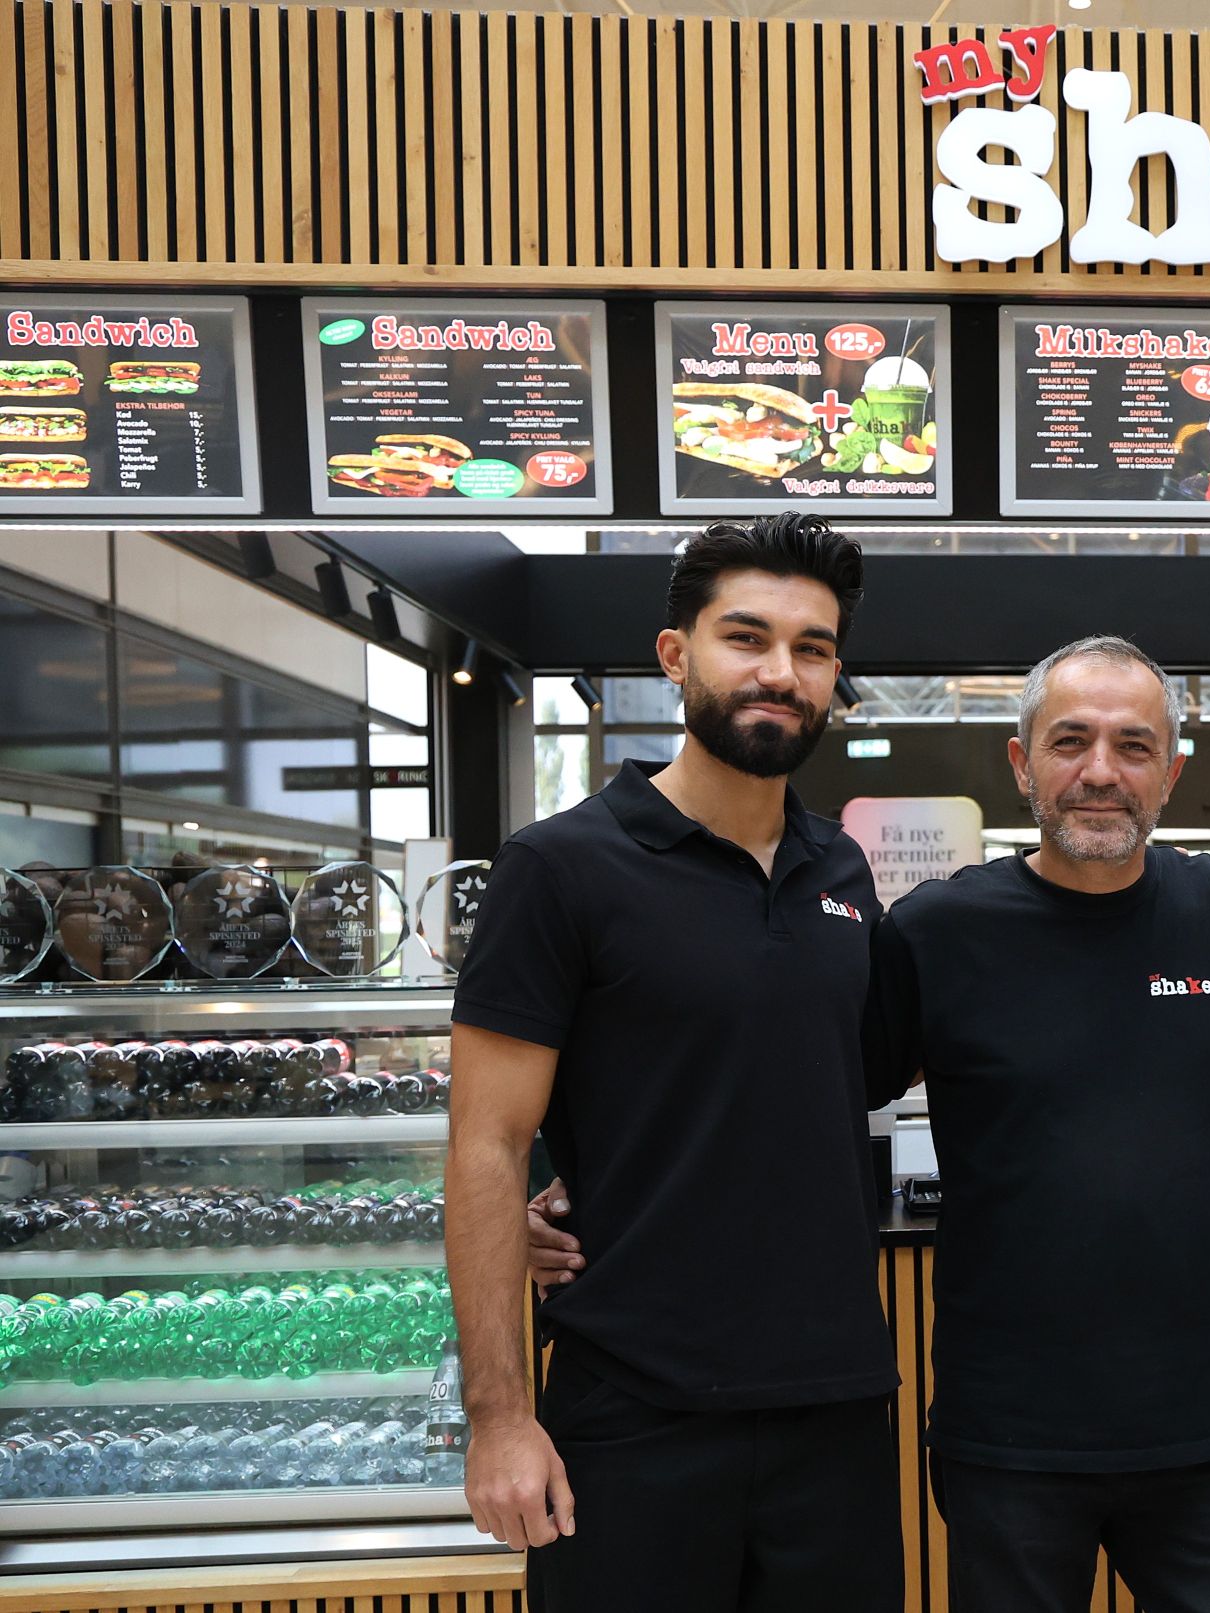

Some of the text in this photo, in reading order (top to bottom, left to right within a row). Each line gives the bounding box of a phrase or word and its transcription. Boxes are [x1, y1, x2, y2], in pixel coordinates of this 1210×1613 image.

[914, 24, 1056, 105] my
[7, 311, 199, 348] Sandwich
[371, 315, 556, 351] Sandwich
[712, 322, 819, 357] Menu
[829, 331, 882, 354] 125,-
[680, 358, 822, 378] Valgfri sandwich
[115, 402, 146, 410] EKSTRA
[116, 419, 149, 427] Avocado
[117, 428, 157, 436] Mozzarella
[118, 445, 142, 453] Tomat
[119, 454, 158, 463] Peberfrugt
[540, 463, 579, 484] 75,-
[120, 480, 141, 489] Karry
[782, 477, 840, 497] Valgfri
[881, 823, 944, 847] Få nye
[869, 844, 956, 867] præmier
[903, 867, 952, 883] mån
[821, 897, 862, 923] shake
[426, 1433, 462, 1447] hake
